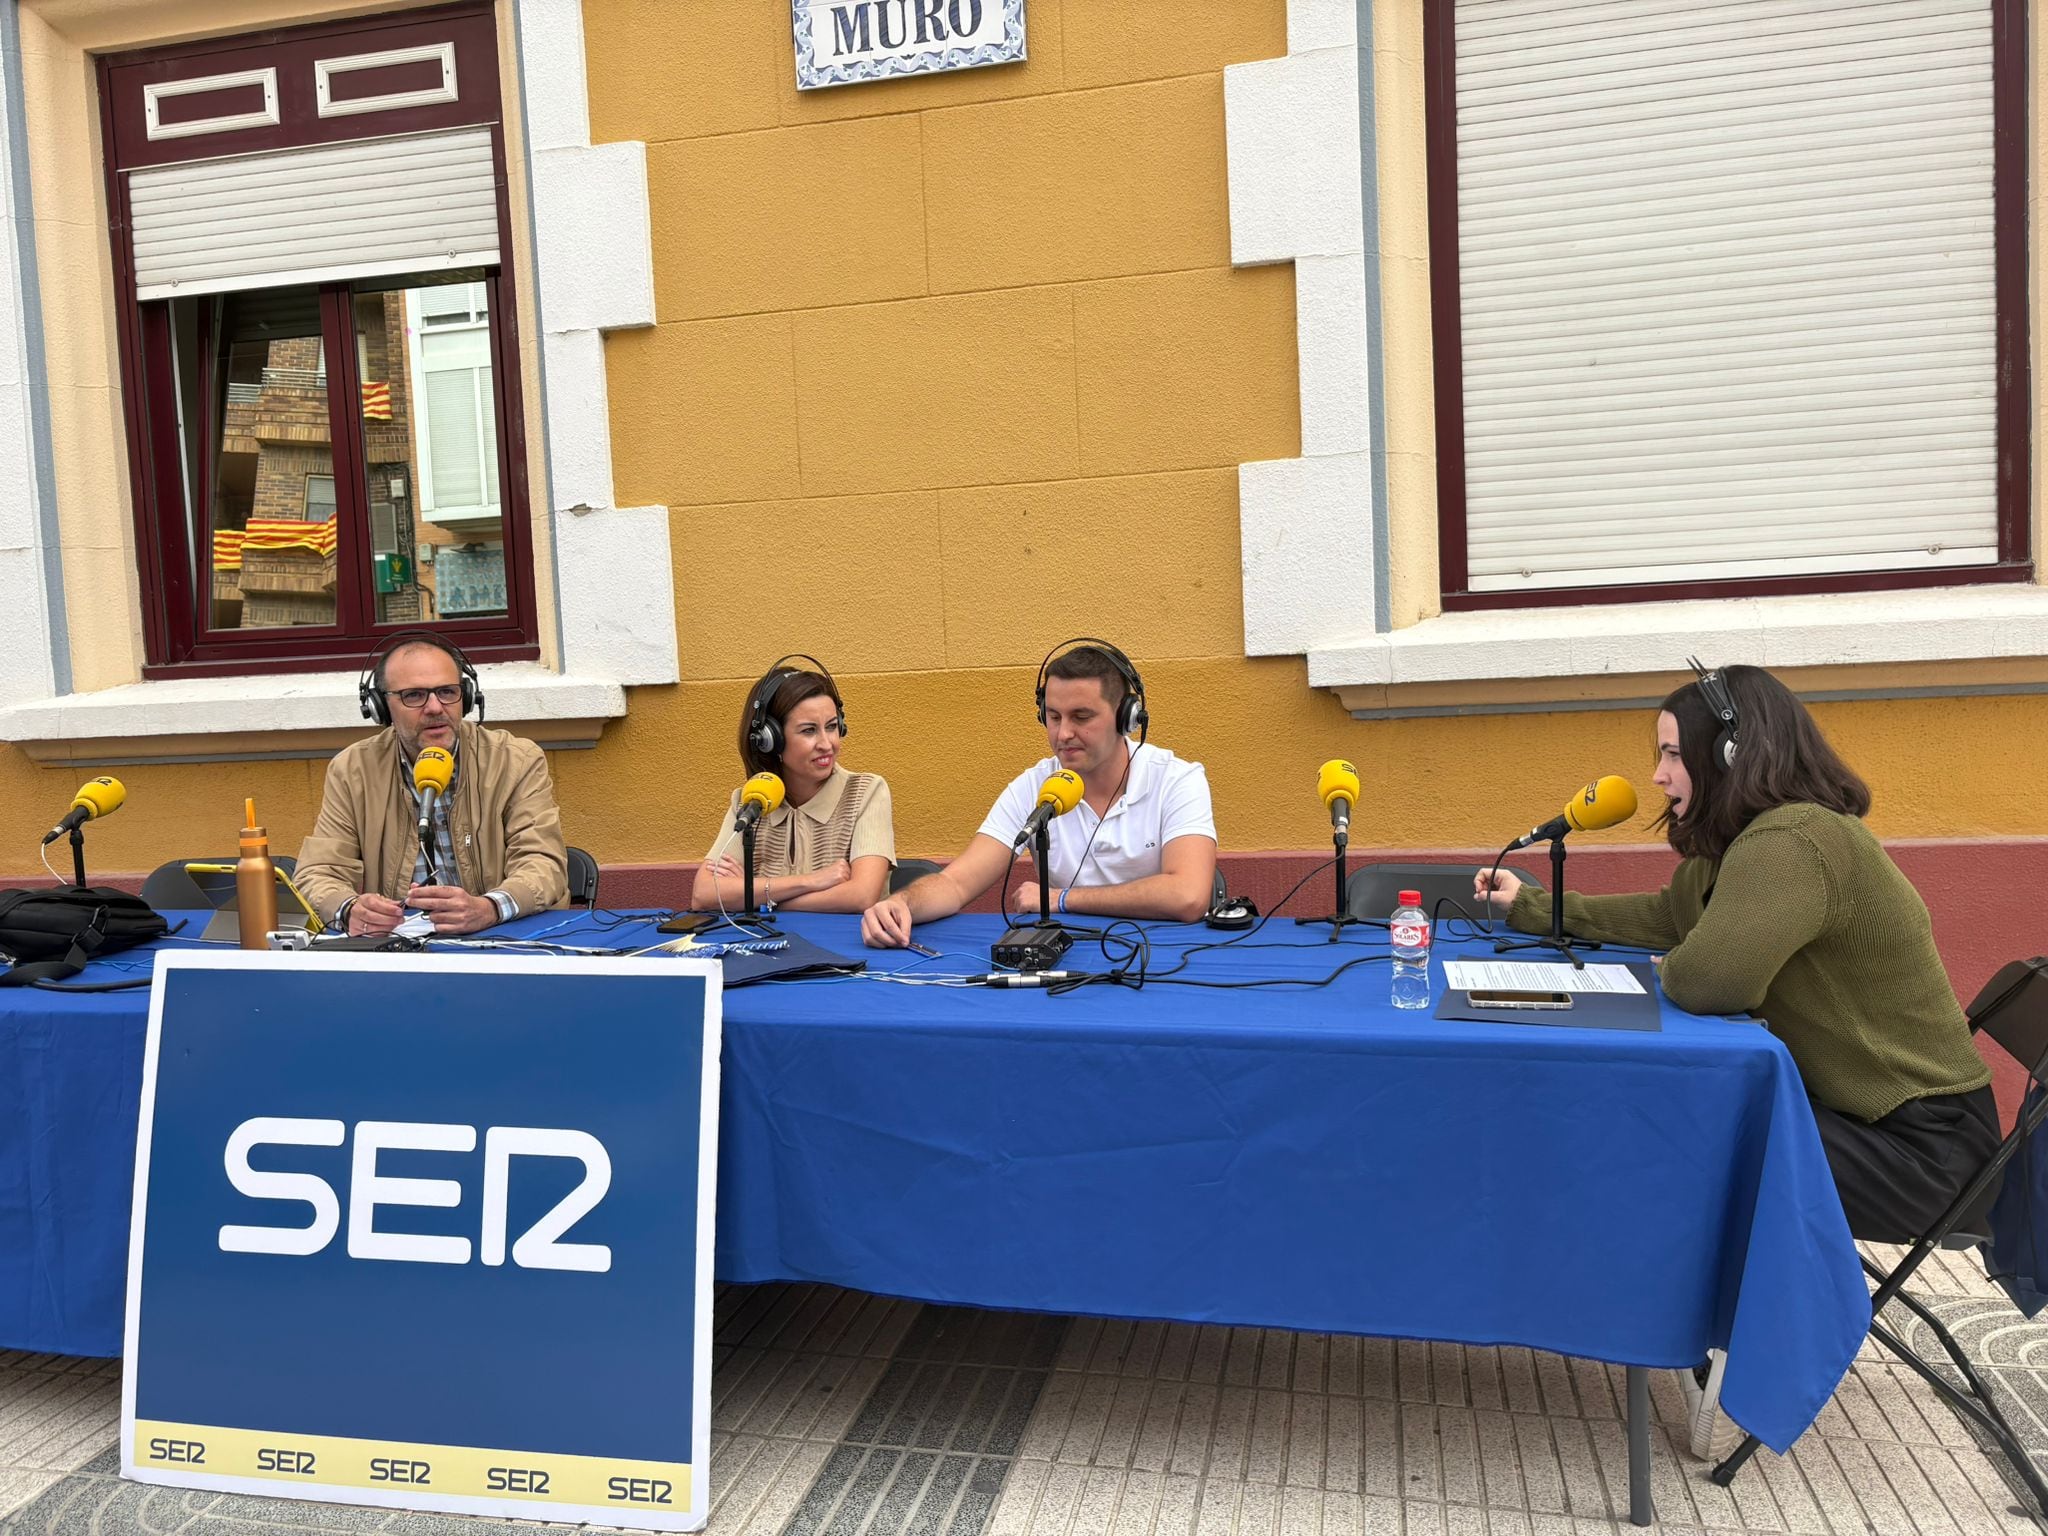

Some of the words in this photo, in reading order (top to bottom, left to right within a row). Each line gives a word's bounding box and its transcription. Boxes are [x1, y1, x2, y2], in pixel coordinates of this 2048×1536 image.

[830, 0, 982, 56] MURO
[218, 1117, 612, 1273] SER
[150, 1439, 205, 1464] SER
[257, 1449, 315, 1475] SER
[369, 1458, 431, 1485] SER
[486, 1468, 550, 1494] SER
[607, 1477, 672, 1504] SER
